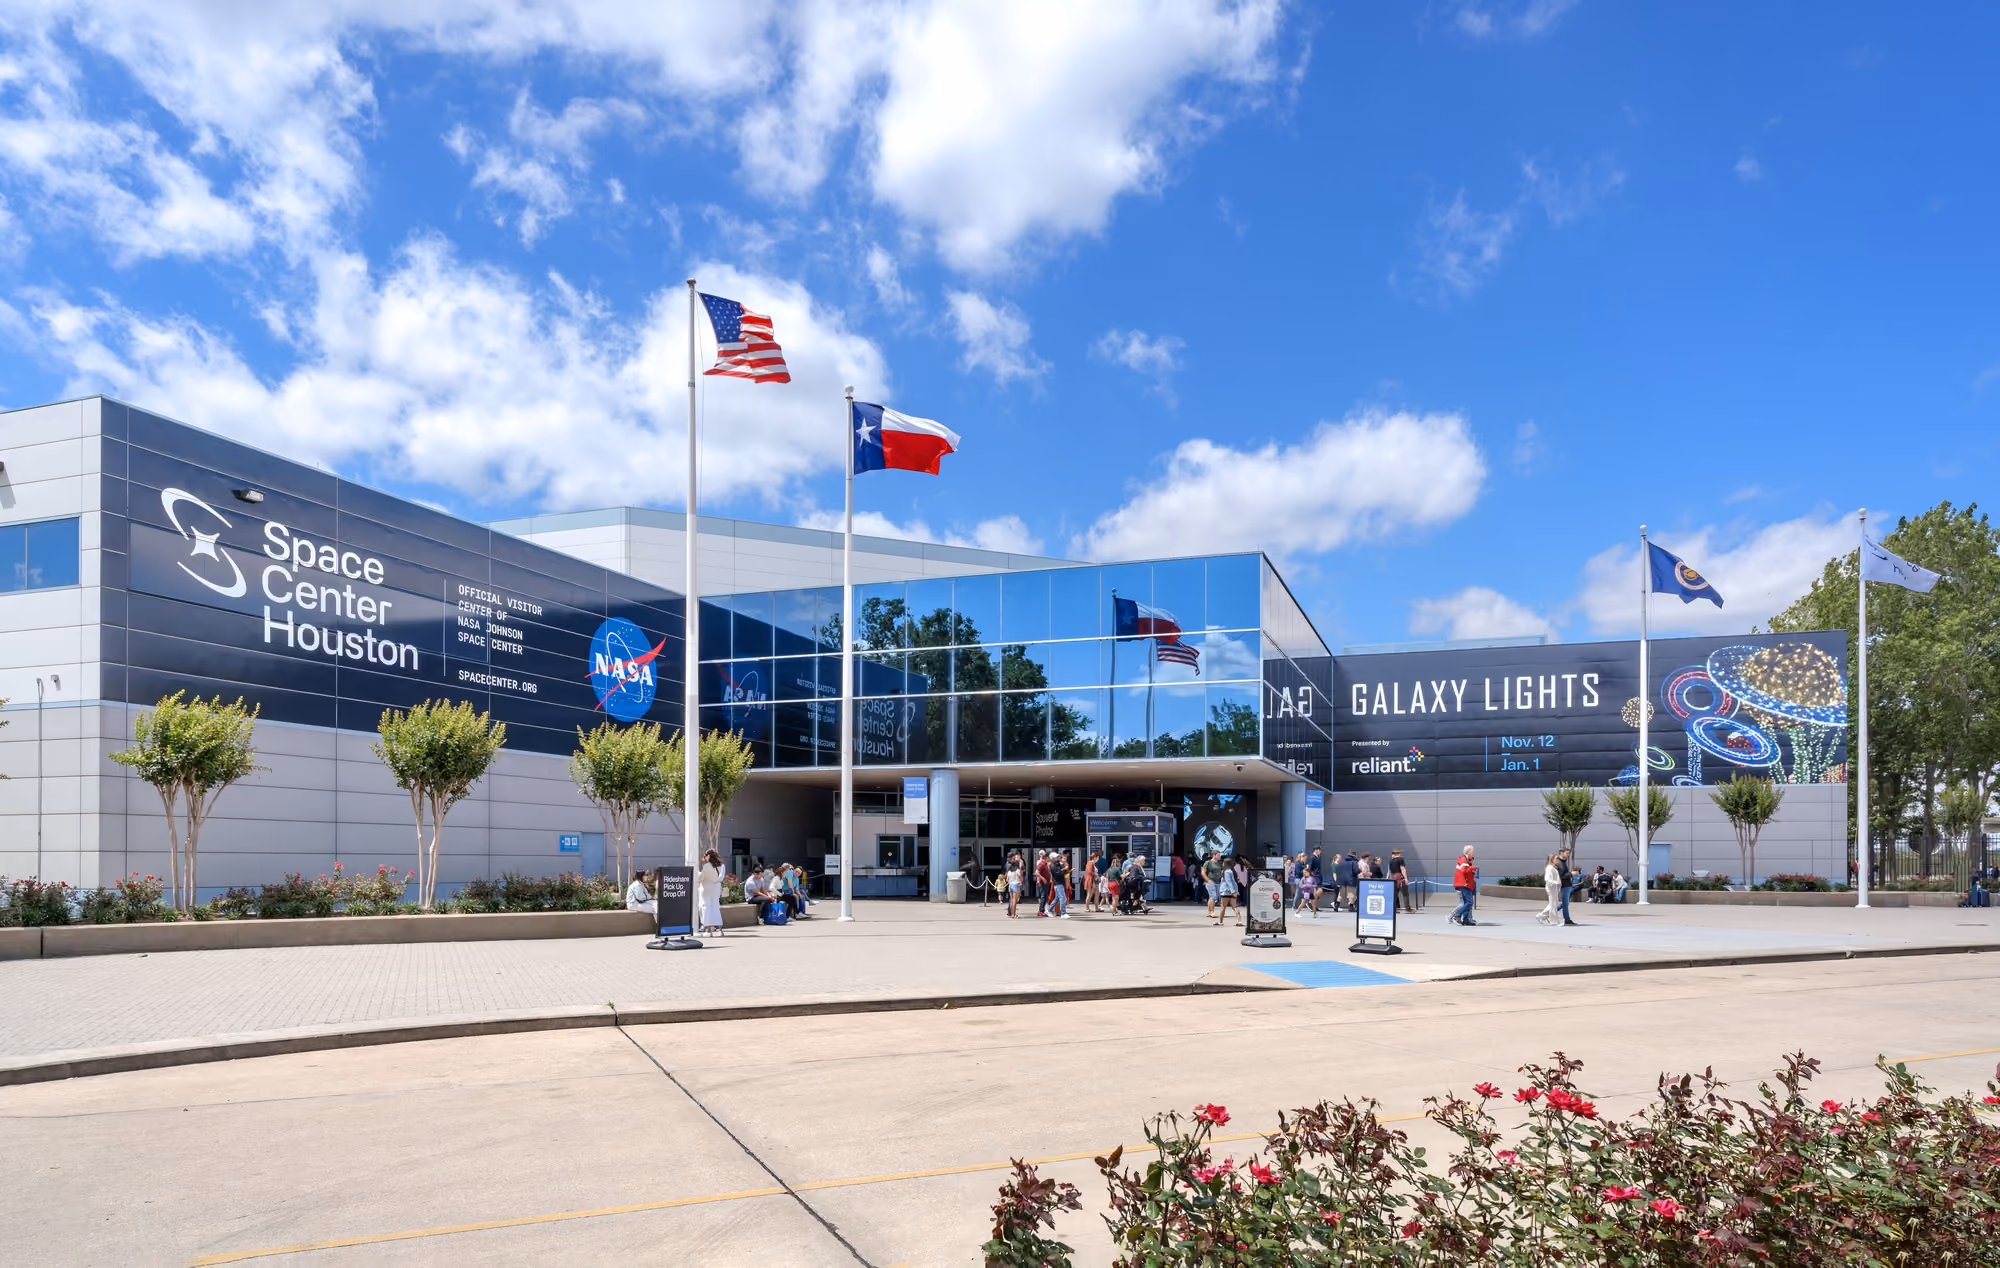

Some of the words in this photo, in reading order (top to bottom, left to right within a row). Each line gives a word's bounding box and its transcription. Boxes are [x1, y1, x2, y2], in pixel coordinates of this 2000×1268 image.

[263, 521, 384, 585] Space
[262, 564, 392, 625] Center
[458, 584, 502, 605] OFFICIAL
[507, 598, 543, 616] VISITOR
[458, 600, 492, 617] CENTER
[496, 610, 508, 621] OF
[263, 605, 418, 671] Houston
[457, 616, 480, 630] NASA
[486, 622, 523, 640] JOHNSON
[458, 632, 485, 647] SPACE
[491, 639, 523, 655] CENTER
[595, 652, 654, 687] NASA
[458, 670, 537, 694] SPACECENTER.ORG
[1352, 679, 1467, 716] GALAXY
[1484, 673, 1599, 711] LIGHTS
[1501, 736, 1535, 749] Nov.
[1538, 735, 1554, 748] 12
[1501, 758, 1530, 771] Jan.
[1534, 758, 1540, 770] 1
[1036, 810, 1059, 824] Souvenir
[1036, 825, 1054, 837] Photos
[663, 890, 677, 898] Drop
